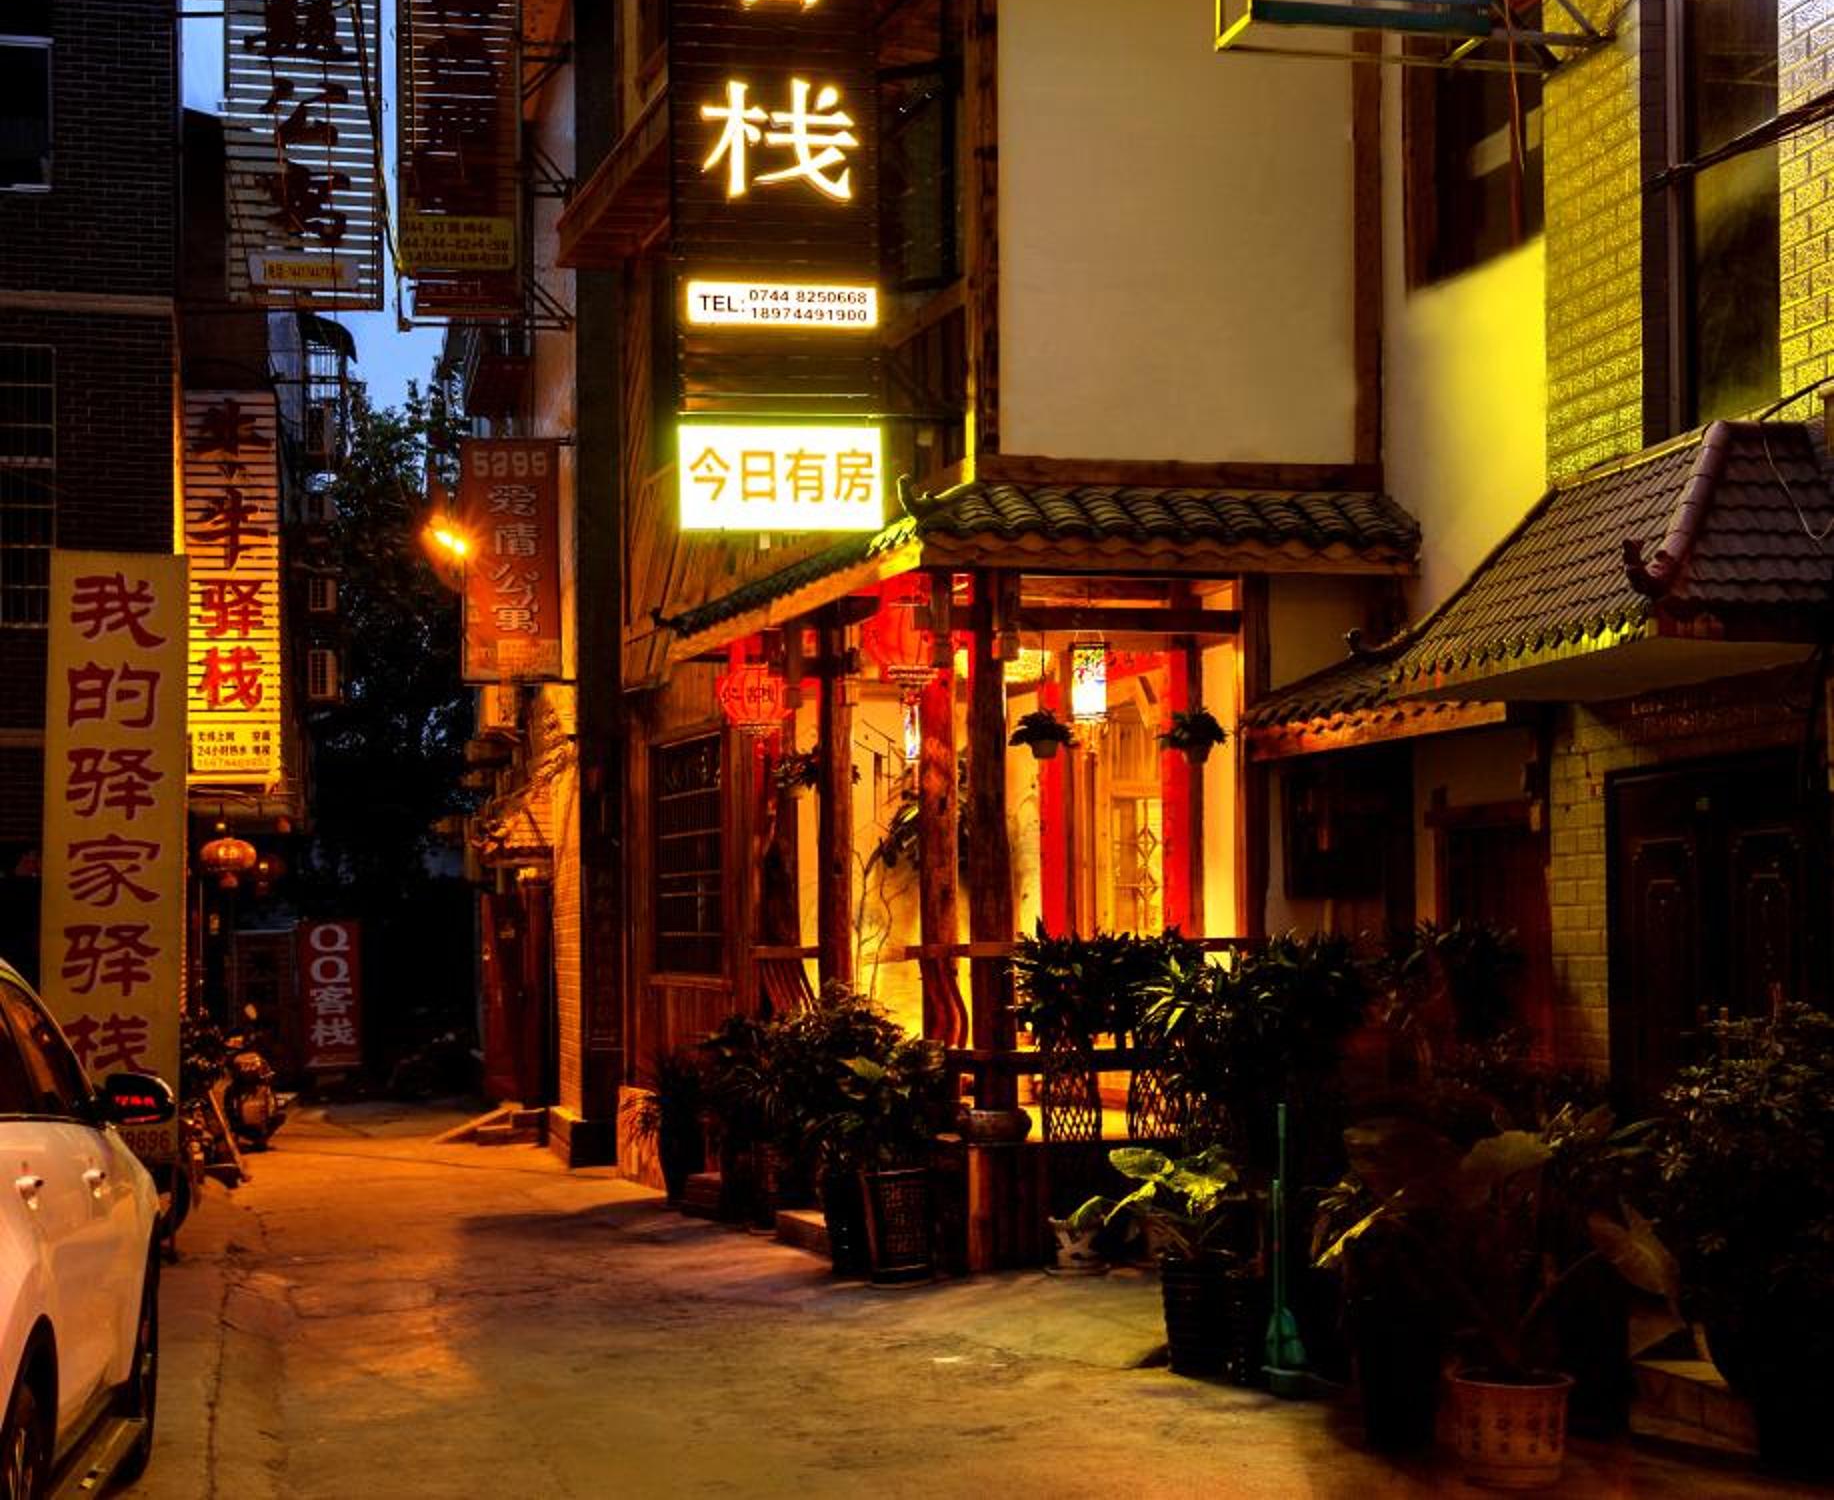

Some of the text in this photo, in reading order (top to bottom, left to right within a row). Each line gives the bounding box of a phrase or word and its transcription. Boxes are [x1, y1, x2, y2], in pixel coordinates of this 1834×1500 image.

[749, 289, 868, 304] 0744 8250668
[751, 307, 868, 321] 18974491900
[689, 447, 876, 503] 今日有房
[62, 572, 168, 1078] 我的驿家驿栈
[309, 923, 357, 1047] QQ客栈
